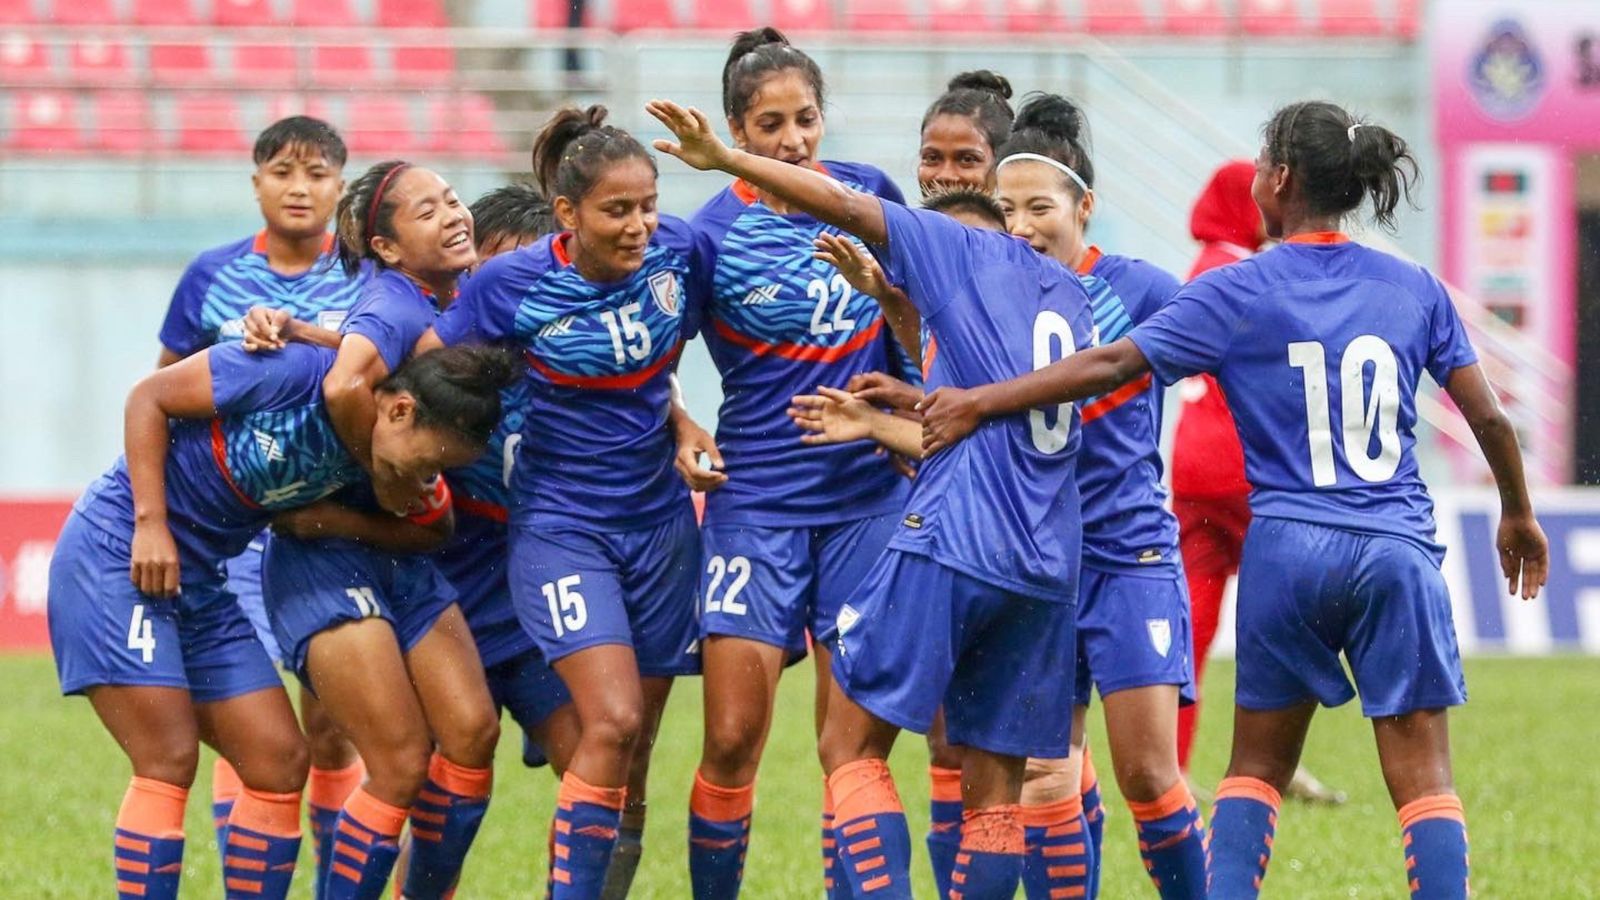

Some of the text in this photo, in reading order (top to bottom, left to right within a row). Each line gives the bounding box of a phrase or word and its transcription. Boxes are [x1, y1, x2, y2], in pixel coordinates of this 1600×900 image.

[600, 302, 652, 364] 15
[807, 273, 855, 335] 22
[1287, 334, 1402, 487] 10
[541, 574, 588, 638] 15
[705, 555, 752, 616] 22
[127, 604, 156, 663] 4
